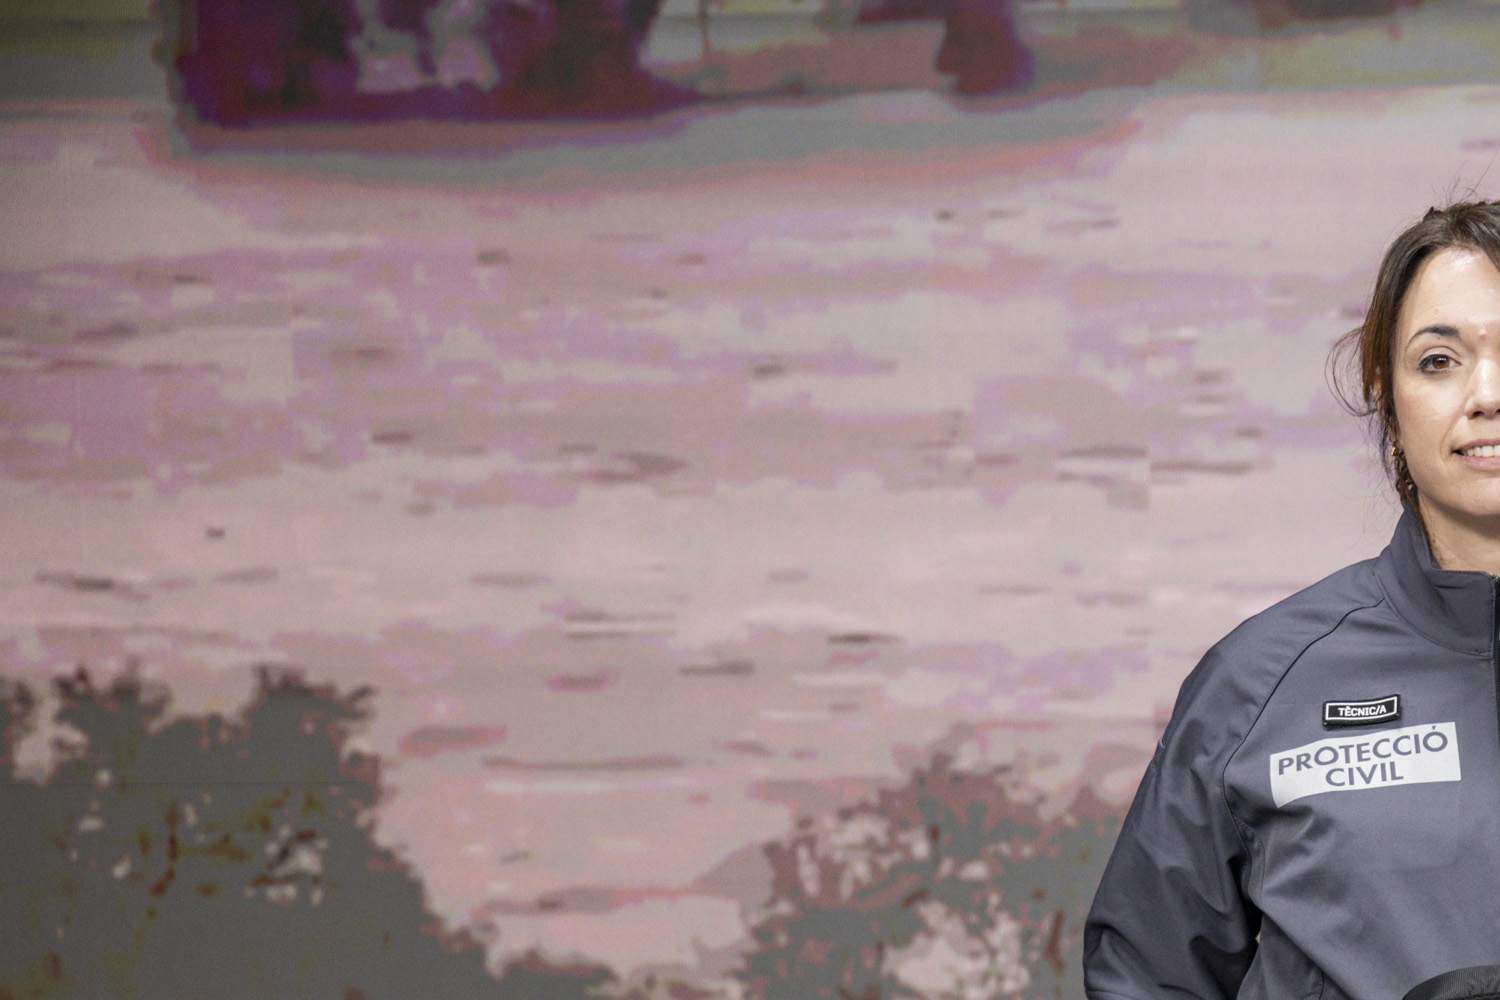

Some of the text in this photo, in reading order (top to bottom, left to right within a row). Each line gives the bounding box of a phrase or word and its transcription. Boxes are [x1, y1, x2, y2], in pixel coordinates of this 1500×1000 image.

[1338, 705, 1387, 717] TÈCNIC/A
[1278, 725, 1448, 776] PROTECCIÓ
[1325, 761, 1404, 787] CIVIL
